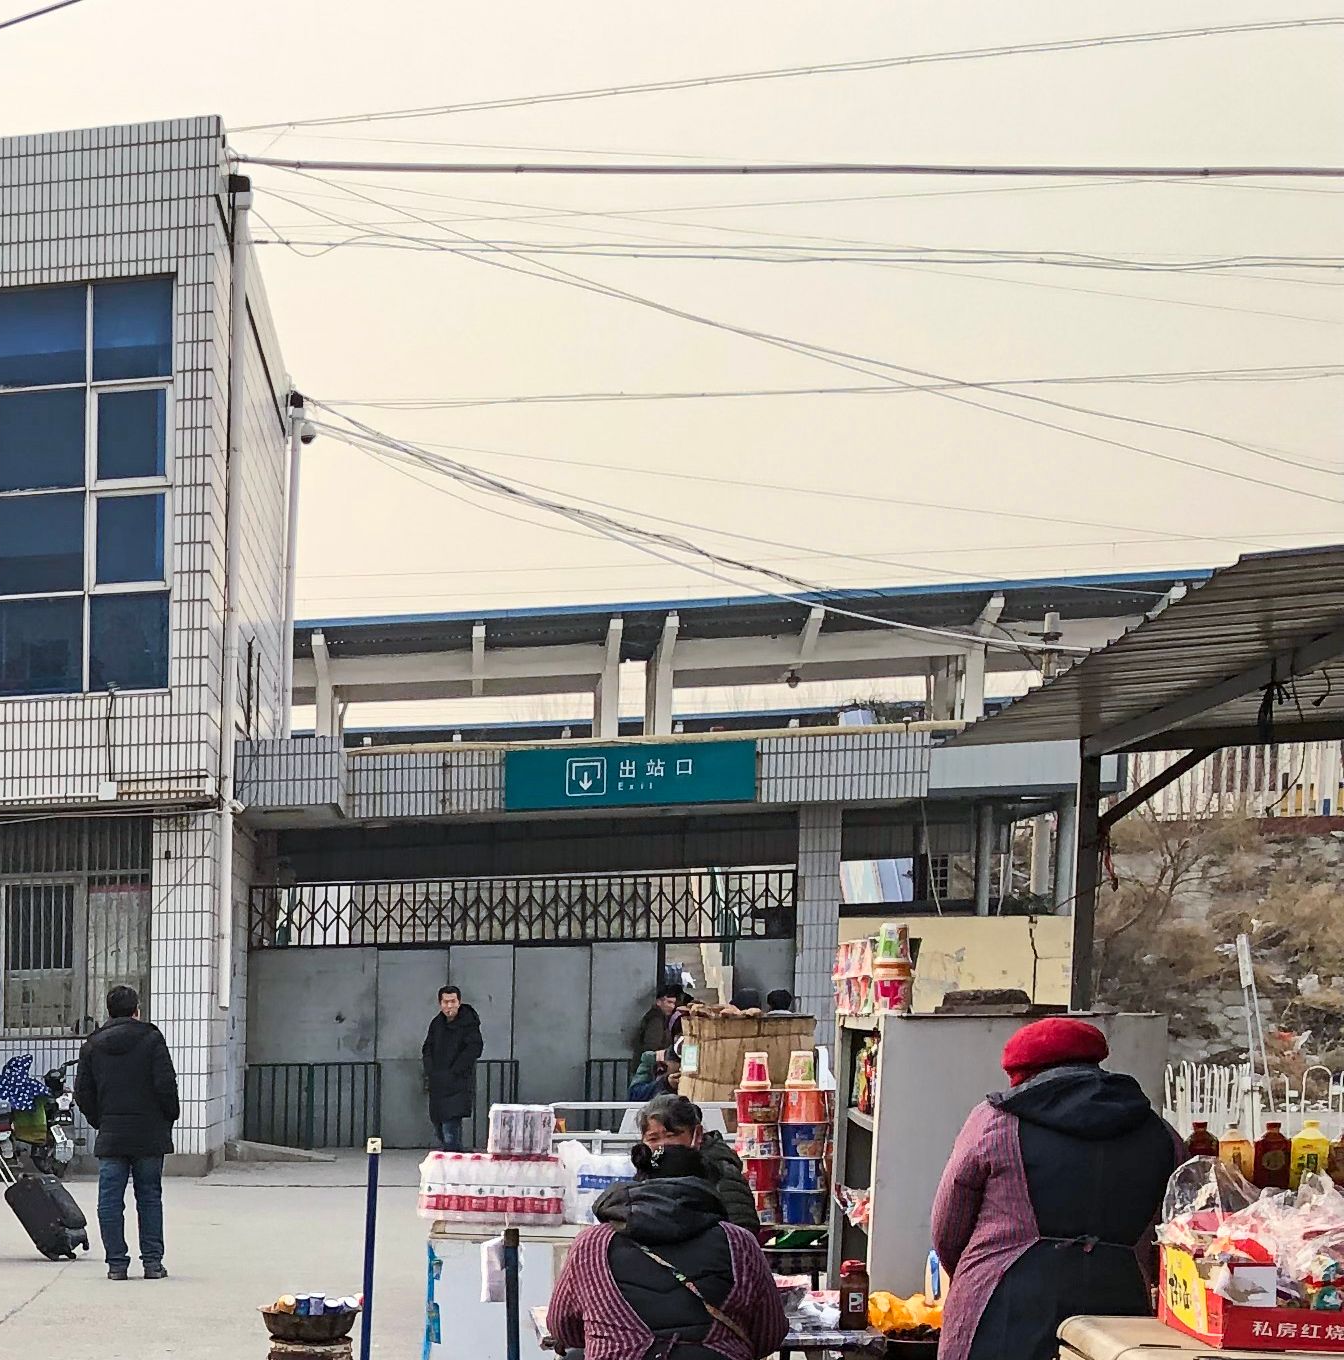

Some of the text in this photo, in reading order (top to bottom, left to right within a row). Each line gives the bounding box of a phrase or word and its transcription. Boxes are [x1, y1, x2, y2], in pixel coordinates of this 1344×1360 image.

[619, 758, 694, 778] 出站口
[618, 781, 654, 791] Exit
